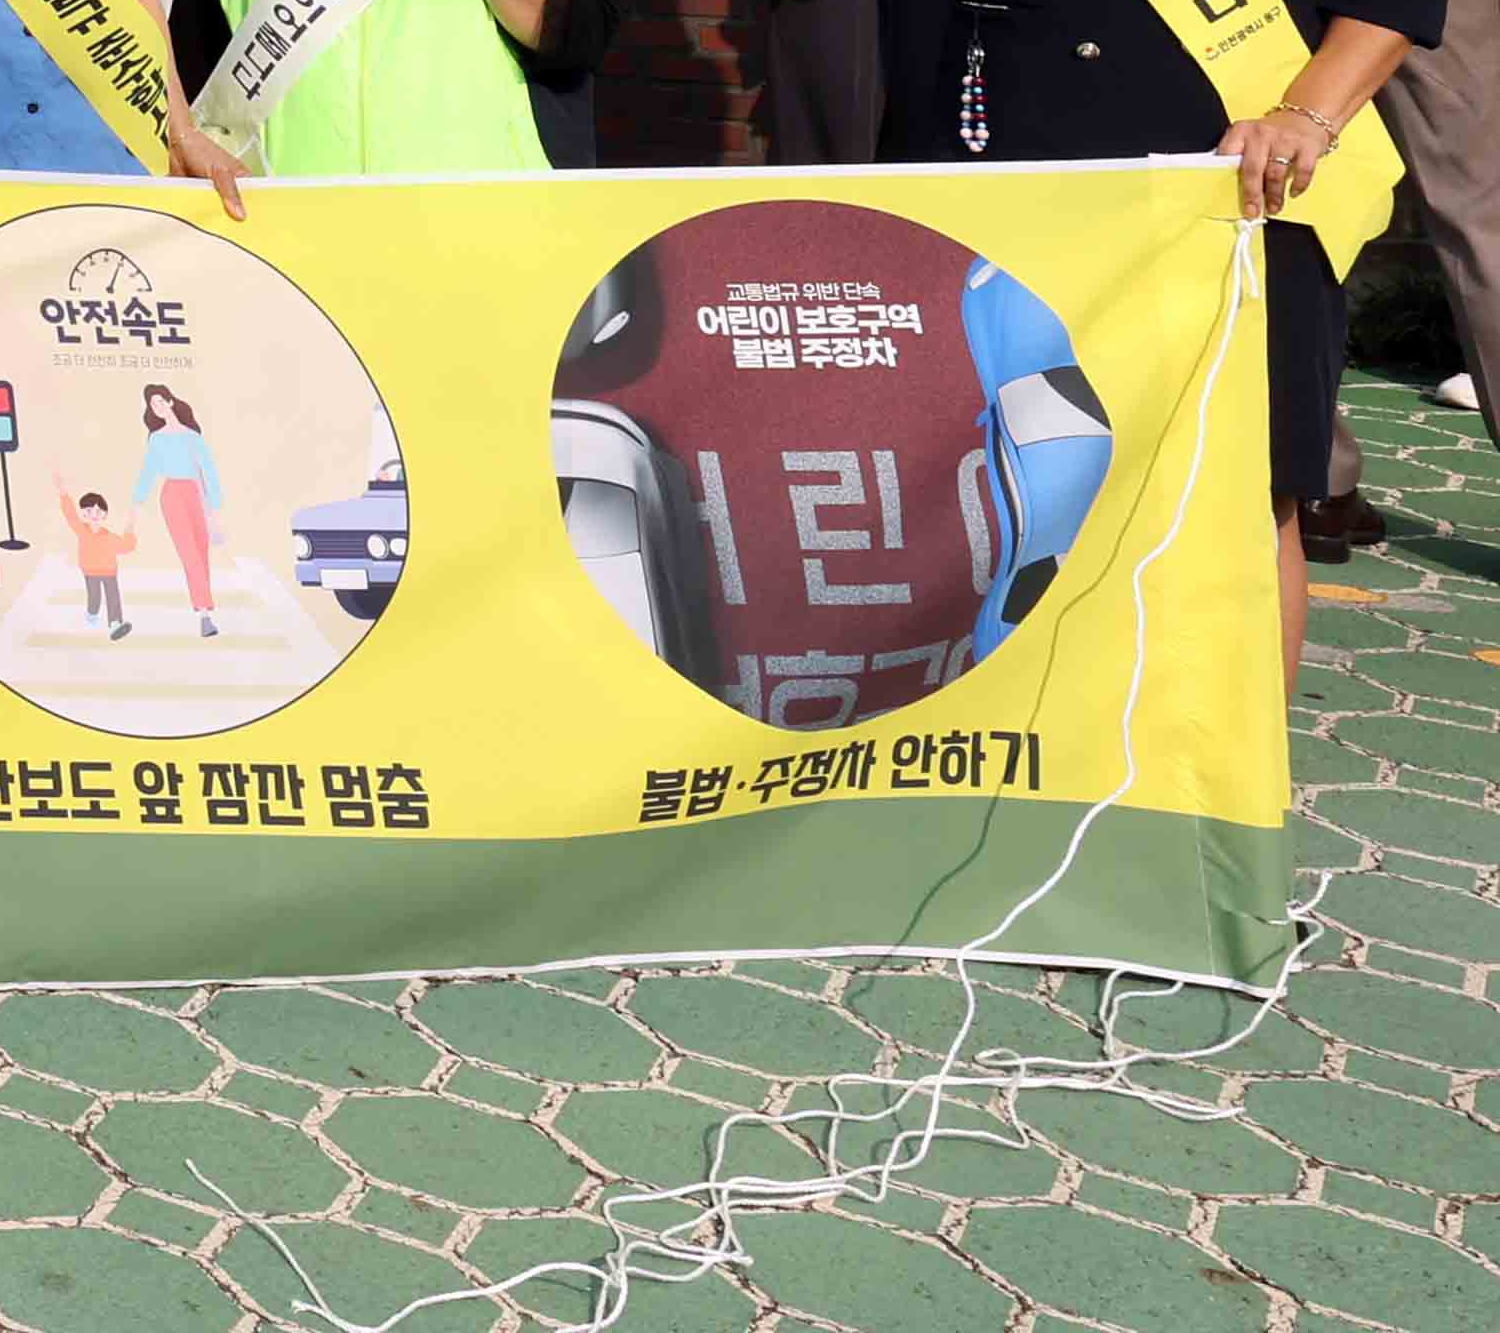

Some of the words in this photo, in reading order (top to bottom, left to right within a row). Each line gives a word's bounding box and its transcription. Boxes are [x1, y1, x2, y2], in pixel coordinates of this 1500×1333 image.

[86, 26, 170, 144] 준수합
[726, 282, 799, 302] 교통법규
[803, 282, 839, 301] 위반
[843, 281, 882, 301] 단속
[40, 297, 192, 346] 안전속도
[697, 305, 791, 336] 어린이
[796, 303, 924, 336] 보호구역
[732, 337, 797, 369] 불법
[800, 337, 899, 370] 주정차
[891, 730, 1042, 792] 안하기
[133, 761, 185, 825] 앞
[198, 763, 306, 826] 잠깐
[321, 763, 432, 830] 멈춤
